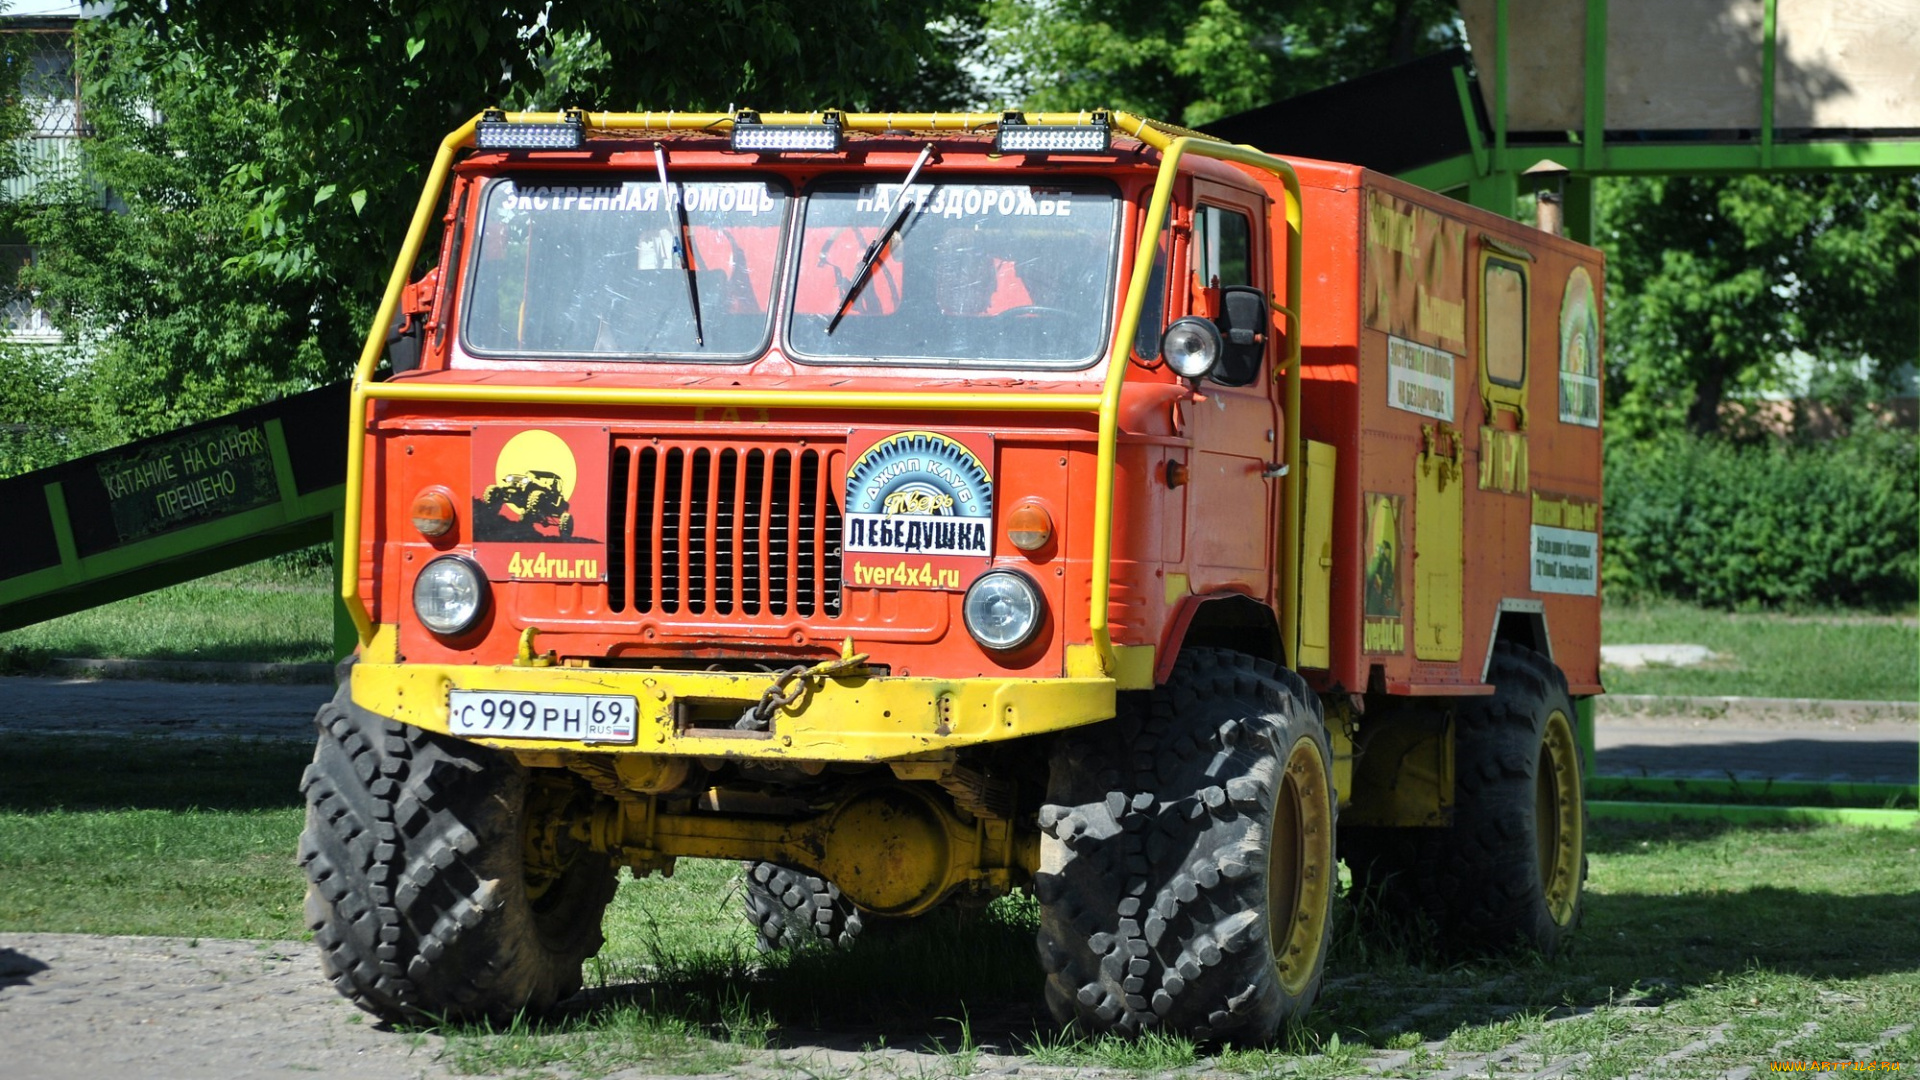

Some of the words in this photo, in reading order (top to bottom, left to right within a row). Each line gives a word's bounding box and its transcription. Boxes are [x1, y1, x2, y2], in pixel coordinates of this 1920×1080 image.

[502, 186, 660, 211] ЭКСТРЕННАЯ
[665, 186, 774, 217] ПОМОЩЬ
[857, 187, 890, 212] НА
[898, 187, 1072, 219] БЕЗДОРОЖЬЕ
[104, 455, 178, 500] КАТАНИЕ
[181, 447, 207, 475] НА
[207, 426, 263, 466] САНЯХ
[156, 470, 236, 518] ПРЕЩЕНО
[866, 458, 920, 501] ДЖИП
[927, 459, 973, 503] КЛУБ
[849, 518, 987, 553] ЛЕБЕДУШКА
[508, 551, 598, 579] 4x4ru.ru
[853, 561, 960, 588] tver4x4.ru
[591, 701, 623, 725] 69
[589, 725, 612, 735] RUS
